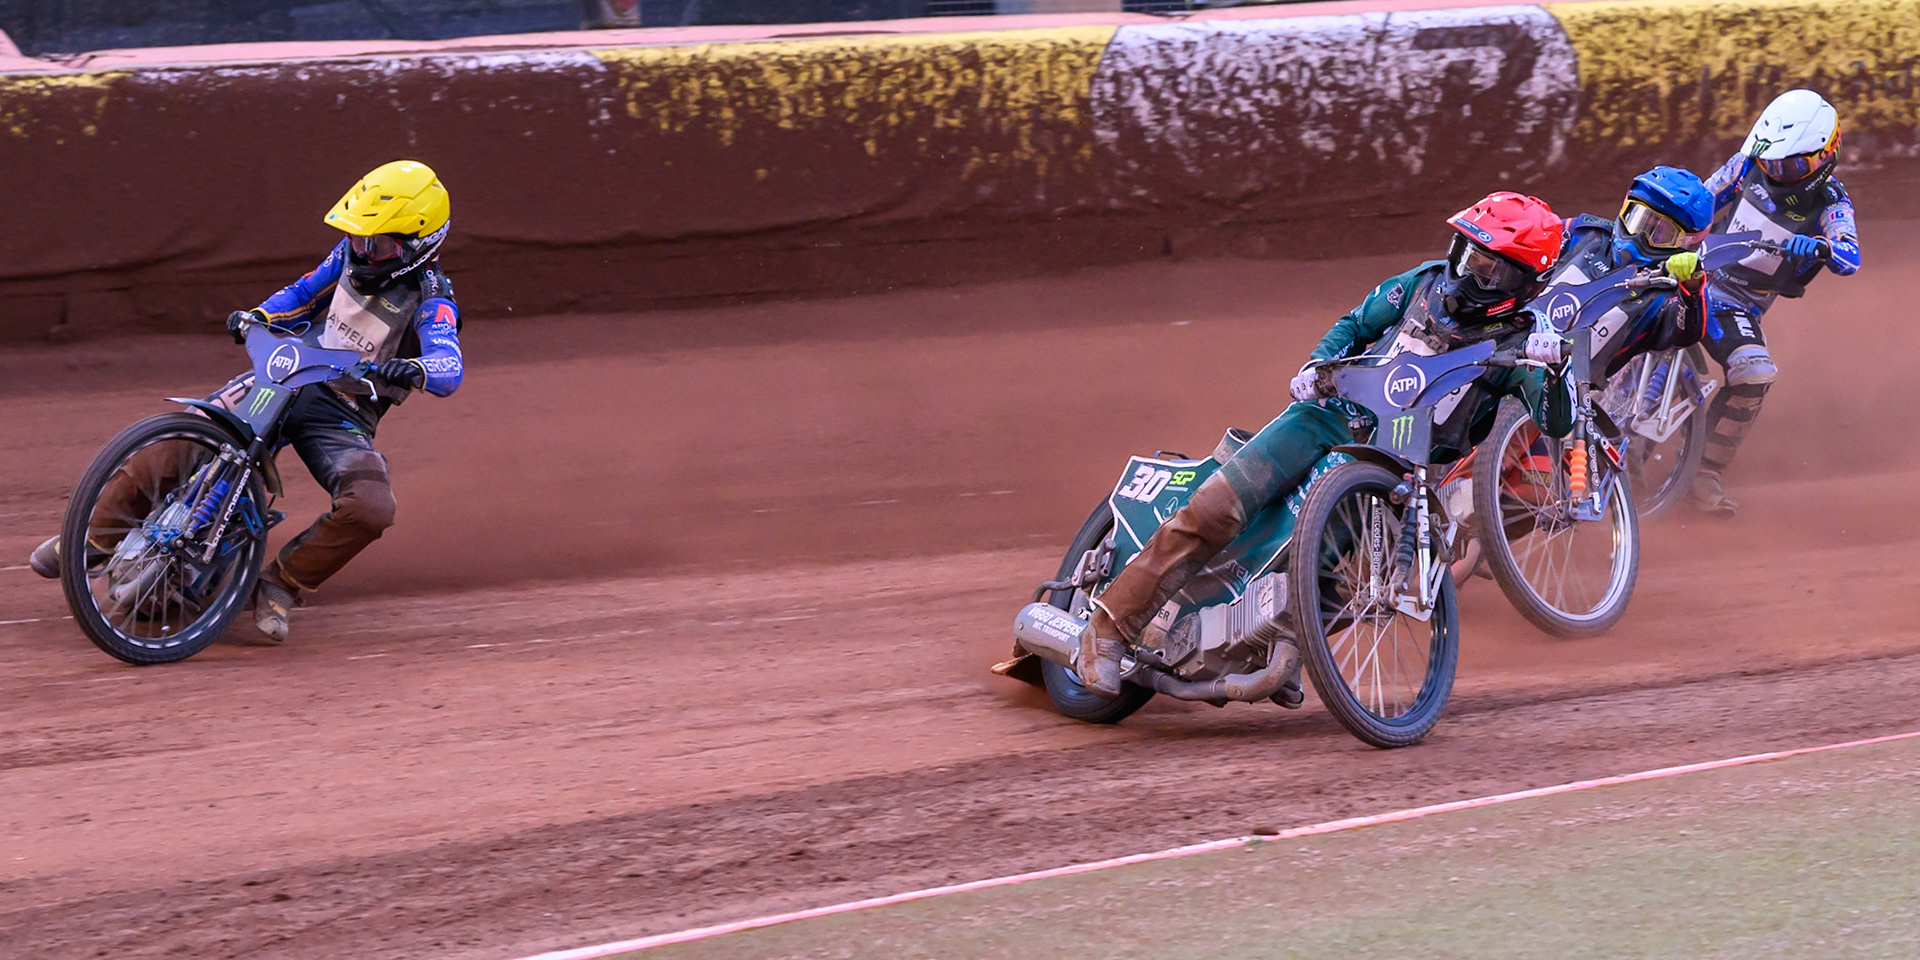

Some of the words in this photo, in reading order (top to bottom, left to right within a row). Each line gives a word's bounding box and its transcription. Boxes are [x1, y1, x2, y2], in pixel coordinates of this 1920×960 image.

[1552, 304, 1575, 321] ATPI
[328, 312, 376, 353] AYFIELD
[271, 355, 294, 371] ATPI
[1390, 376, 1418, 395] ATPI
[1118, 463, 1172, 504] 30
[1169, 470, 1196, 485] SGP
[1028, 606, 1054, 623] VIGGO
[1042, 624, 1071, 642] TRANSPORT
